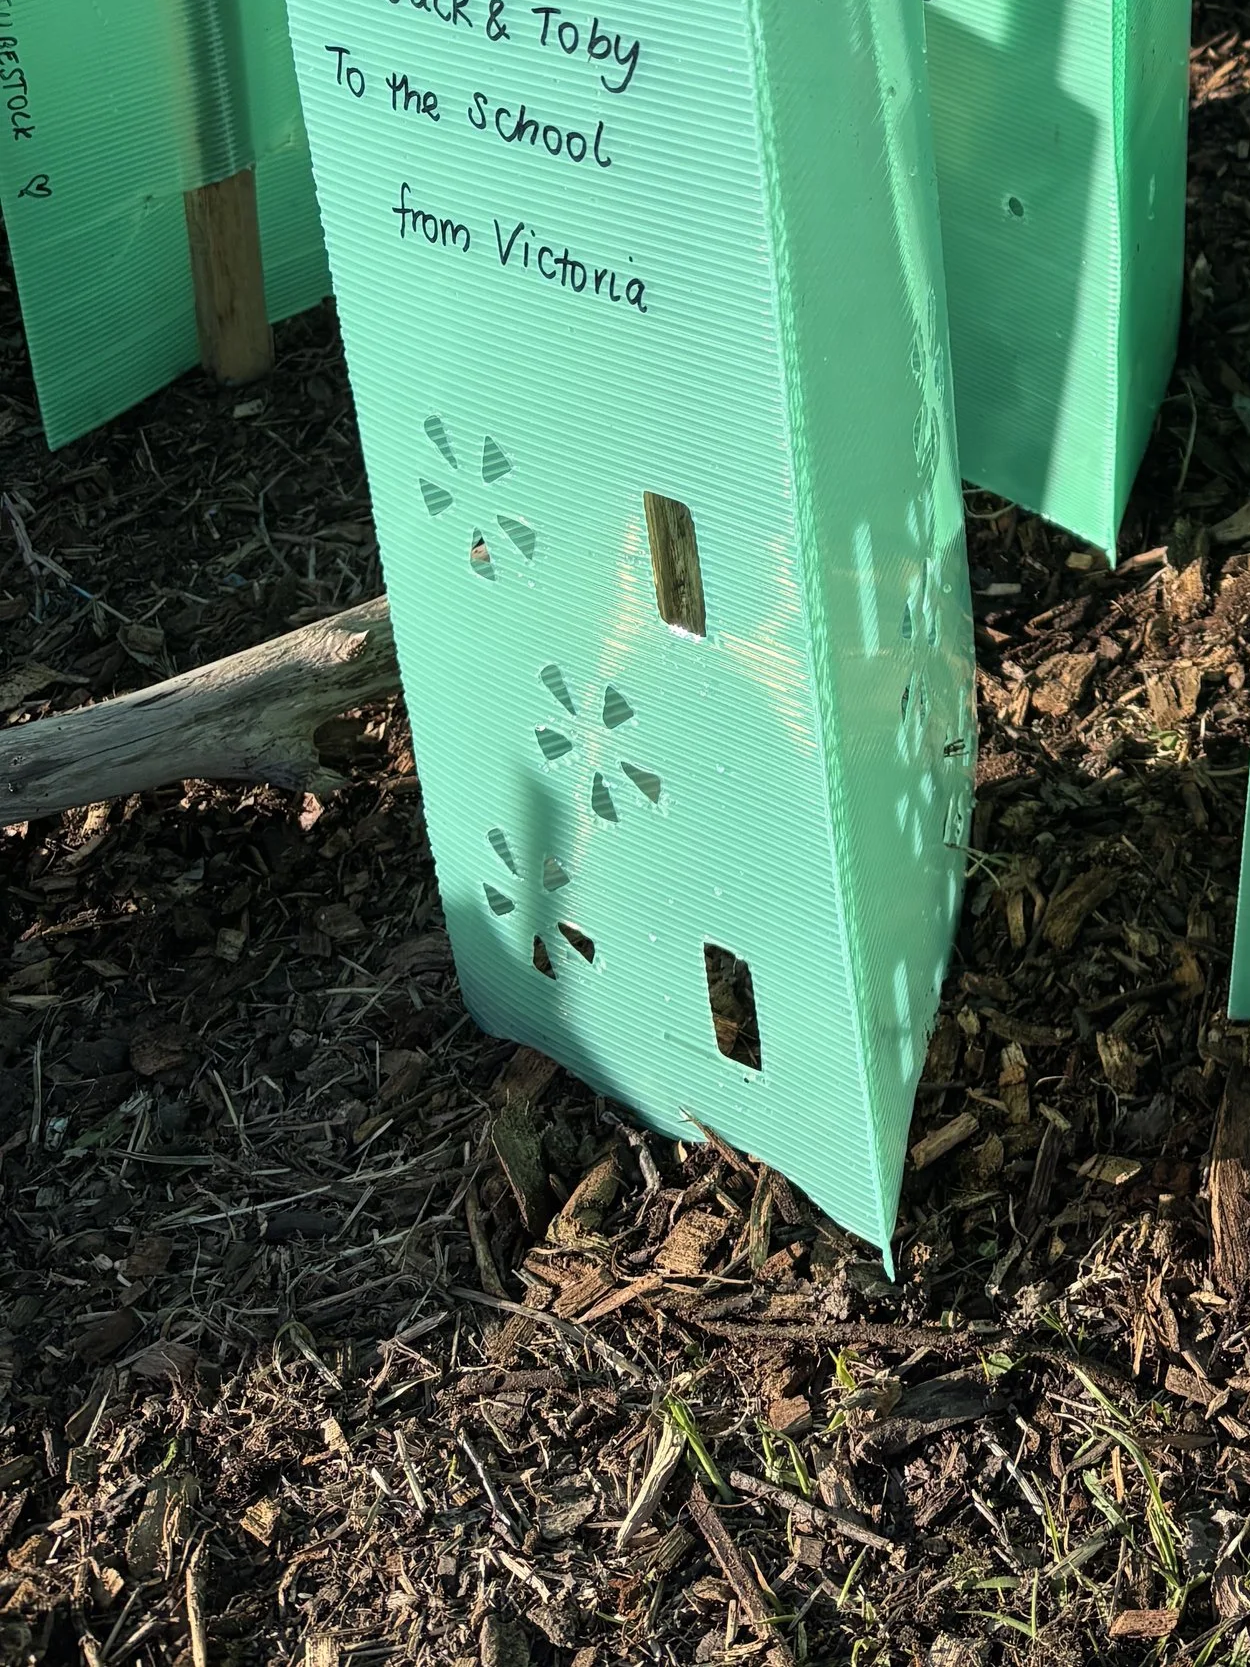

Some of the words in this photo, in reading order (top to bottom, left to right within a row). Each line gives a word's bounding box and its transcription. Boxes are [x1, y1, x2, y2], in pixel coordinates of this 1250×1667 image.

[324, 45, 366, 98] To
[385, 72, 441, 122] the
[531, 6, 641, 94] Toby
[391, 181, 472, 253] from
[493, 218, 649, 314] Victoria
